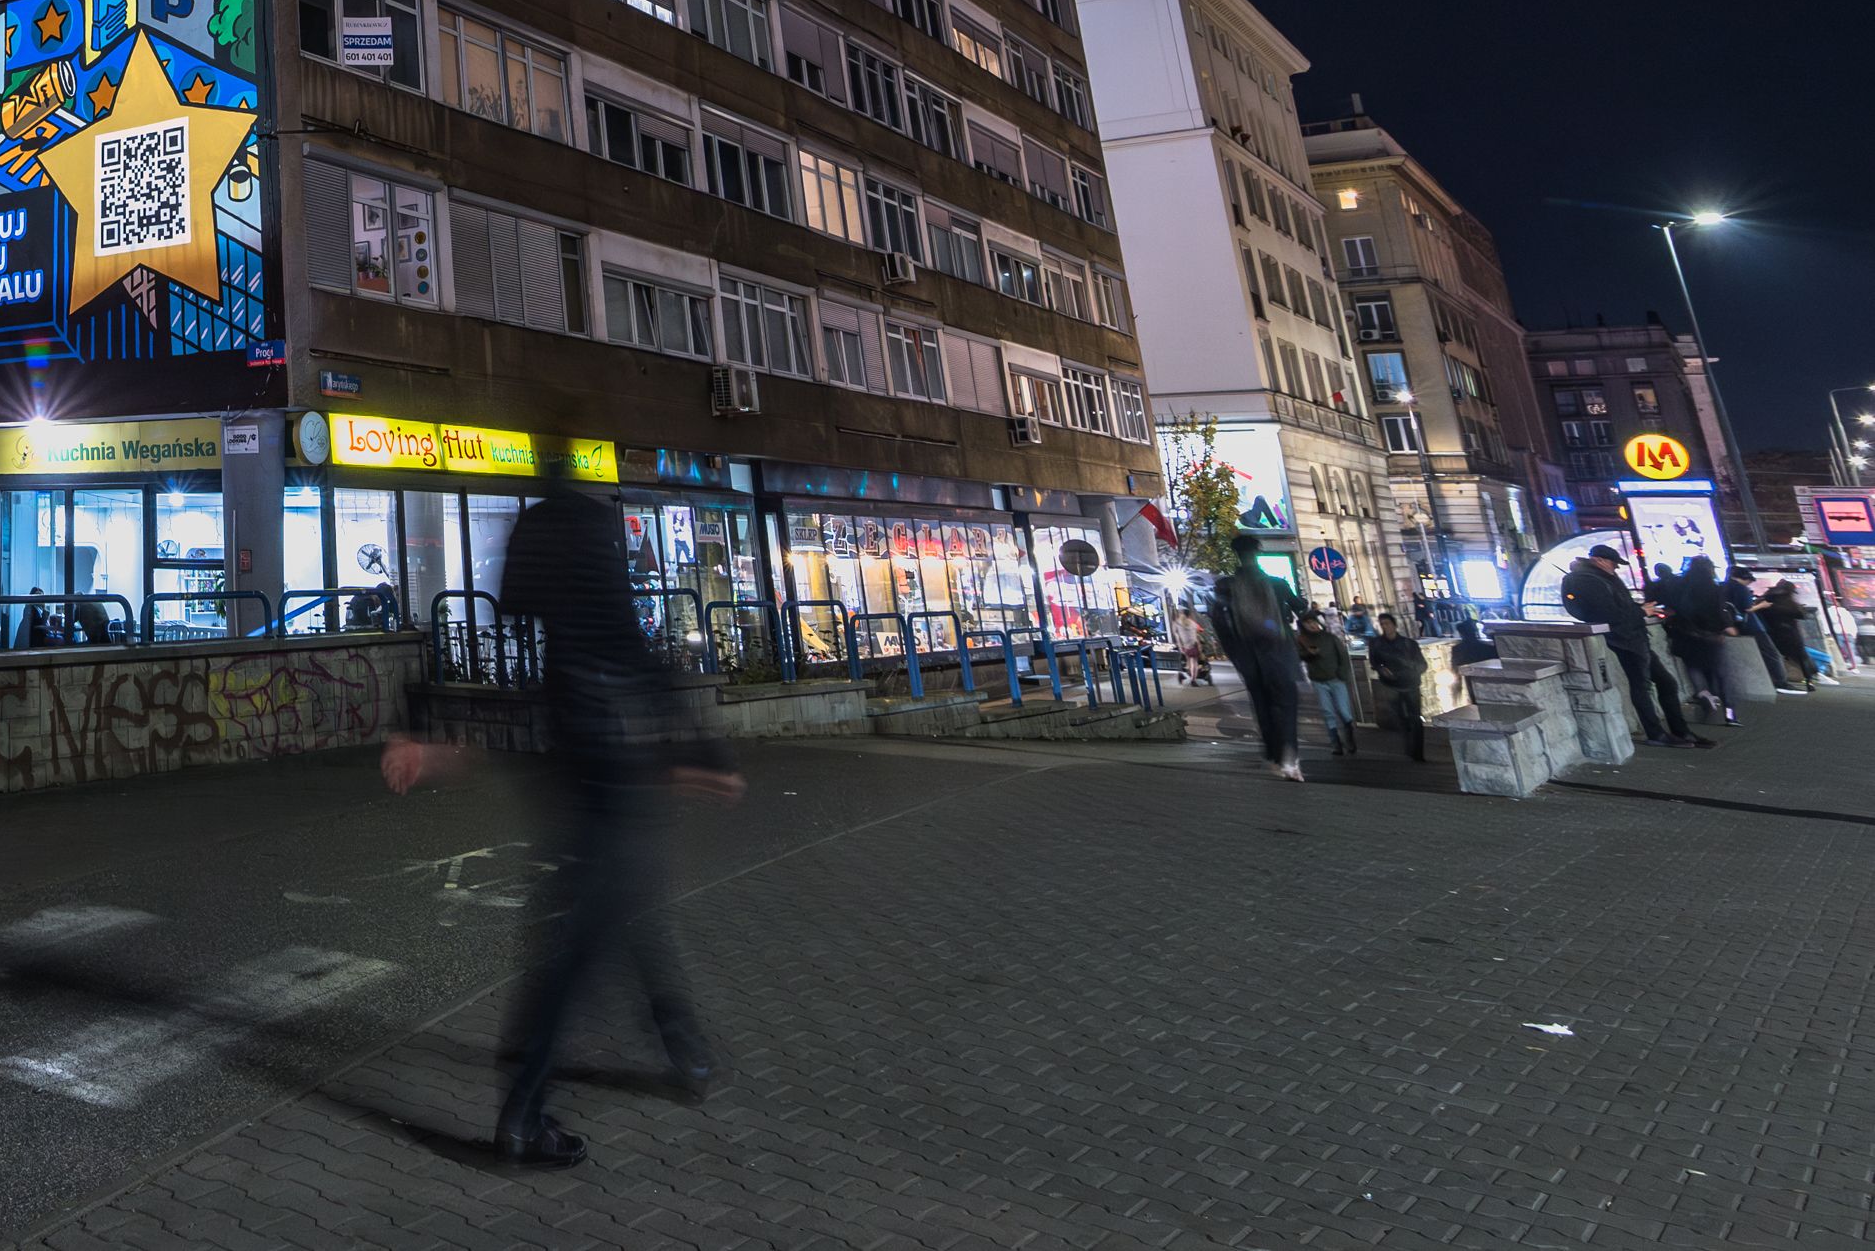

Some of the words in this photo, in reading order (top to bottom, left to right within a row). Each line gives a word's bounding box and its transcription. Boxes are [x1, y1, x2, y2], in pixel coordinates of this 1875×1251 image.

[343, 36, 392, 46] SPRZEDAM
[345, 52, 360, 61] 601
[361, 52, 376, 61] 401
[377, 52, 392, 61] 401
[122, 438, 217, 464] Wegańska
[348, 420, 438, 467] Loving
[443, 429, 485, 461] Hut
[491, 441, 536, 465] kuchnia
[794, 527, 818, 542] SKLEP
